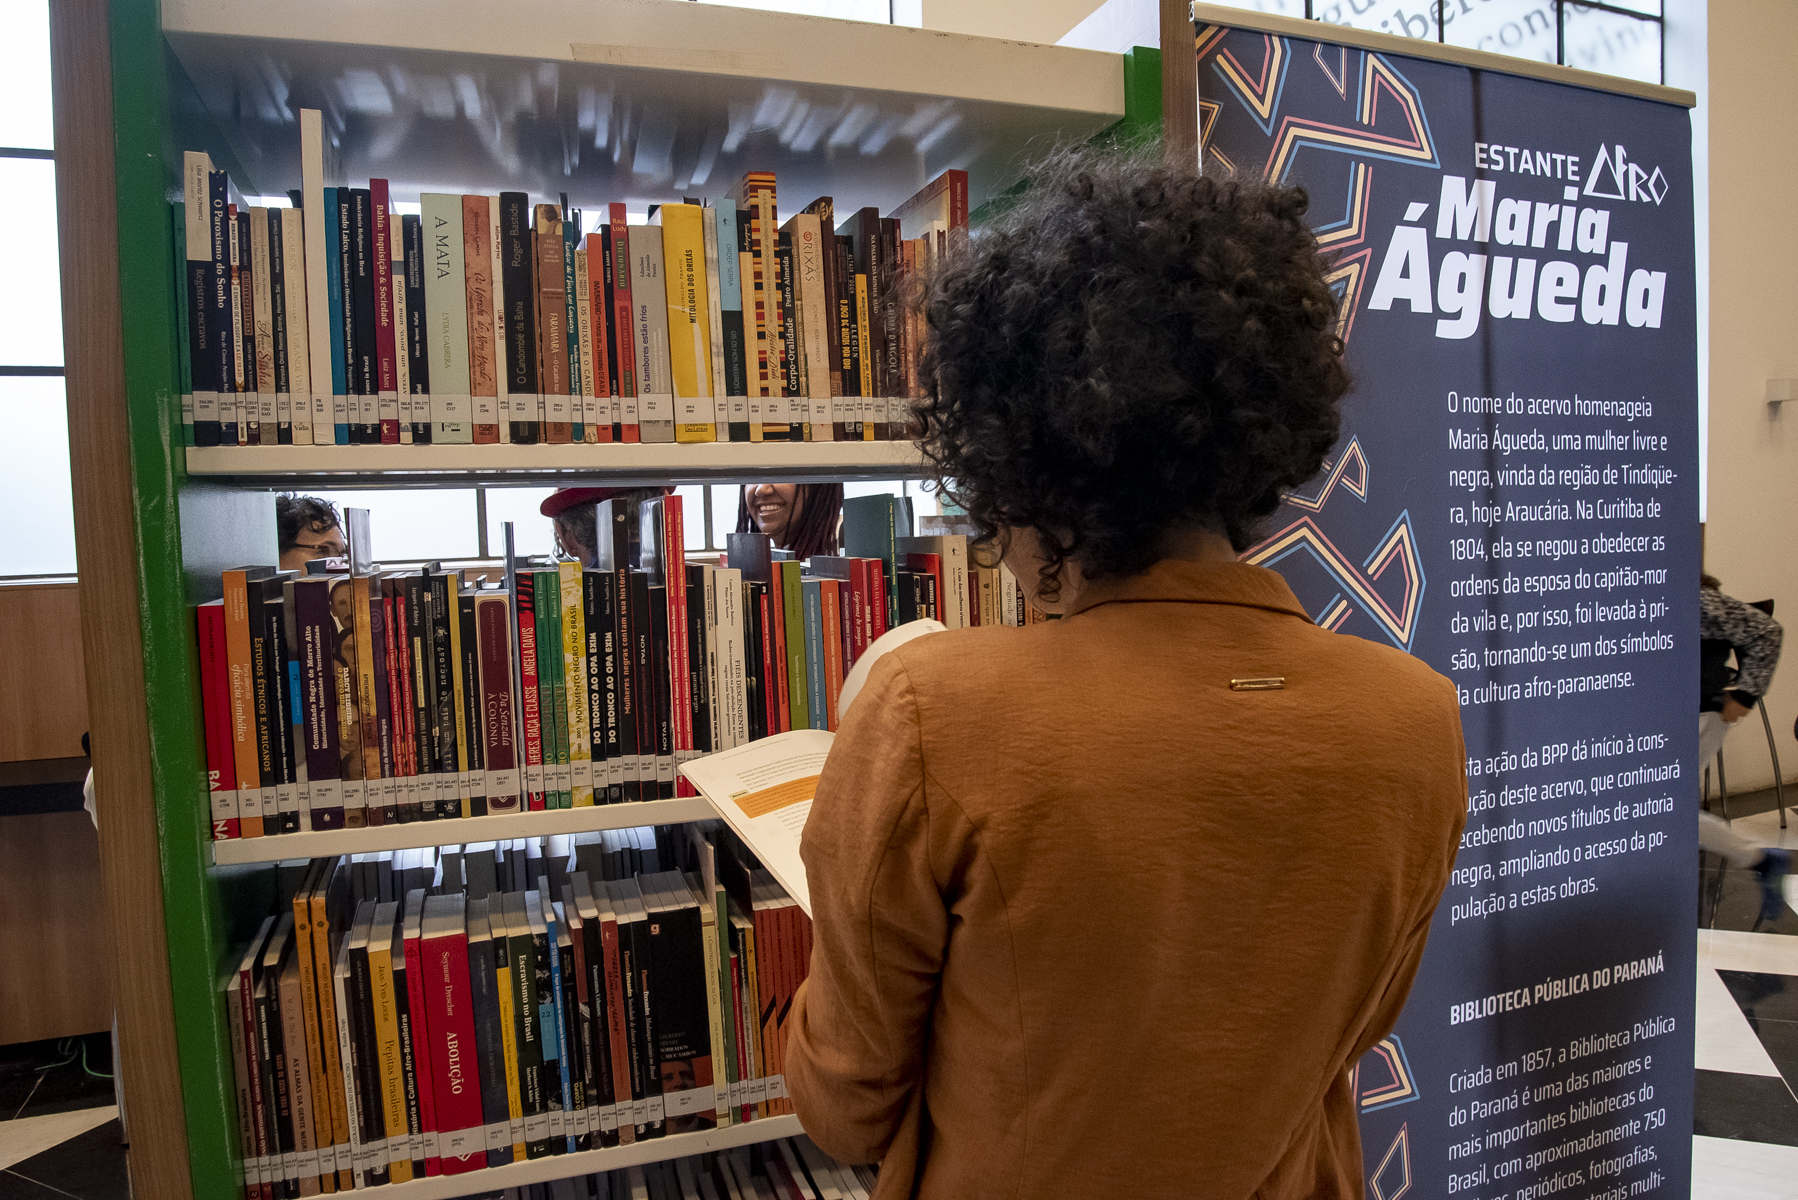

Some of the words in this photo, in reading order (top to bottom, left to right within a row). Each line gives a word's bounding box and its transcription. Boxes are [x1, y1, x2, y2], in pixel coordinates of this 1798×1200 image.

[1475, 141, 1581, 182] ESTANTE
[1583, 141, 1669, 206] AFRO
[213, 199, 223, 208] O
[376, 204, 385, 231] Bahia:
[1435, 174, 1610, 254] Maria
[214, 210, 224, 260] Paroxismo
[435, 216, 448, 228] A
[216, 262, 225, 275] do
[376, 233, 387, 275] Inquisição
[435, 235, 450, 279] MATA
[684, 249, 694, 272] ORIXÁS
[782, 256, 791, 284] Almeida
[686, 274, 695, 287] DOS
[1367, 202, 1667, 339] Águeda
[195, 268, 206, 313] Registros
[216, 277, 226, 309] Sonho
[380, 286, 389, 327] Sociedade
[689, 288, 697, 324] MITOLOGIA
[784, 284, 792, 307] Pedro
[639, 304, 648, 322] frios
[197, 315, 207, 350] escravos
[640, 323, 649, 344] estão
[642, 346, 651, 381] tambores
[785, 317, 798, 391] Corpo-Oralidade
[643, 383, 651, 394] Os
[1448, 391, 1458, 413] O
[1463, 397, 1502, 414] nome
[1506, 392, 1523, 414] do
[1528, 399, 1571, 415] acervo
[1575, 394, 1652, 421] homenageia
[1449, 427, 1488, 450] Maria
[1492, 424, 1548, 455] Águeda,
[1553, 435, 1581, 450] uma
[1586, 429, 1630, 450] mulher
[1633, 430, 1657, 450] livre
[1661, 436, 1667, 451] e
[1450, 470, 1493, 491] negra,
[1497, 464, 1535, 486] vinda
[1539, 464, 1555, 485] da
[1559, 464, 1599, 490] região
[1603, 464, 1618, 485] de
[1621, 464, 1677, 489] Tindiqüe-
[1450, 507, 1467, 526] ra,
[1472, 501, 1501, 527] hoje
[1505, 499, 1572, 521] Araucária.
[1577, 500, 1593, 519] Na
[1597, 498, 1643, 519] Curitiba
[1647, 497, 1660, 518] de
[1450, 538, 1488, 561] 1804,
[1493, 536, 1512, 558] ela
[1517, 541, 1532, 557] se
[1537, 540, 1577, 561] negou
[1581, 539, 1588, 554] a
[1593, 532, 1649, 553] obedecer
[1652, 536, 1665, 551] as
[618, 568, 626, 599] história
[1451, 574, 1499, 597] ordens
[1503, 572, 1519, 593] da
[1524, 575, 1570, 596] esposa
[1575, 568, 1590, 589] do
[1595, 566, 1667, 592] capitão-mor
[569, 604, 578, 629] BRASIL
[619, 600, 627, 615] sua
[1451, 611, 1468, 633] da
[1473, 609, 1496, 631] vila
[1501, 614, 1512, 632] e,
[1517, 612, 1539, 633] por
[1543, 605, 1571, 627] isso,
[1575, 602, 1591, 623] foi
[1596, 599, 1635, 622] levada
[1640, 599, 1646, 618] à
[1650, 597, 1669, 622] pri-
[522, 627, 534, 648] DAVIS
[571, 631, 579, 643] NO
[588, 632, 597, 653] EXIM
[620, 617, 628, 647] contam
[254, 637, 264, 676] ESTUDOS
[524, 650, 535, 676] ANGELA
[572, 646, 580, 674] NEGRO
[589, 655, 598, 674] OPA
[621, 649, 630, 675] negras
[1452, 648, 1480, 671] são,
[1484, 641, 1566, 666] tornando-se
[1571, 642, 1591, 658] um
[1595, 635, 1617, 656] dos
[1621, 630, 1673, 654] símbolos
[256, 679, 267, 715] ÉTNICOS
[574, 675, 583, 723] MOVIMENTO
[590, 676, 598, 690] AO
[622, 679, 631, 714] Mulheres
[1474, 681, 1520, 704] cultura
[1525, 672, 1634, 699] afro-paranaense.
[591, 693, 601, 729] TRONCO
[260, 725, 271, 772] AFRICANOS
[593, 731, 601, 744] DO
[1486, 751, 1517, 777] ação
[1522, 747, 1537, 768] da
[1543, 743, 1568, 765] BPP
[1572, 740, 1587, 761] dá
[1592, 735, 1623, 758] início
[1627, 734, 1633, 753] à
[1638, 734, 1668, 751] cons-
[1500, 784, 1537, 806] deste
[1541, 779, 1587, 800] acervo,
[1591, 775, 1614, 796] que
[1618, 759, 1680, 787] continuará
[1459, 818, 1524, 849] ecebendo
[1529, 816, 1567, 836] novos
[1571, 805, 1610, 829] títulos
[1614, 801, 1629, 821] de
[1632, 793, 1673, 818] autoria
[1452, 864, 1495, 887] negra,
[1499, 845, 1569, 877] ampliando
[1574, 847, 1581, 862] o
[1585, 838, 1627, 860] acesso
[1631, 830, 1645, 851] da
[1649, 831, 1667, 852] po-
[1452, 893, 1505, 926] pulação
[1509, 893, 1517, 909] a
[1522, 885, 1556, 906] estas
[1560, 876, 1598, 898] obras.
[518, 954, 530, 1003] Escravismo
[1451, 988, 1531, 1025] BIBLIOTECA
[1535, 973, 1589, 1004] PÚBLICA
[1593, 968, 1610, 989] DO
[1614, 950, 1664, 984] PARANÁ
[523, 1004, 531, 1015] no
[401, 1013, 412, 1071] Afro-Brasileiras
[523, 1016, 534, 1042] Brasil
[385, 1039, 396, 1076] Pepitas
[446, 1031, 463, 1095] ABOLIÇÃO
[1450, 1065, 1492, 1093] Criada
[1497, 1062, 1517, 1080] em
[1522, 1048, 1554, 1073] 1857,
[1559, 1048, 1566, 1063] a
[1571, 1031, 1629, 1059] Biblioteca
[1634, 1016, 1675, 1042] Pública
[406, 1072, 415, 1099] Cultura
[1449, 1106, 1466, 1127] do
[1471, 1089, 1518, 1121] Paraná
[1522, 1086, 1530, 1105] é
[1534, 1082, 1562, 1102] uma
[1567, 1072, 1589, 1092] das
[1593, 1058, 1641, 1085] maiores
[1645, 1056, 1651, 1069] e
[388, 1077, 401, 1128] brasileiras
[409, 1106, 419, 1135] História
[1449, 1138, 1481, 1161] mais
[1486, 1111, 1566, 1151] importantes
[1570, 1091, 1635, 1123] bibliotecas
[1639, 1082, 1653, 1102] do
[1449, 1163, 1489, 1194] Brasil,
[1494, 1158, 1521, 1179] com
[1526, 1118, 1641, 1171] aproximadamente
[1644, 1108, 1665, 1131] 750
[1589, 1144, 1658, 1180] fotografias,
[1631, 1169, 1665, 1196] multi-
